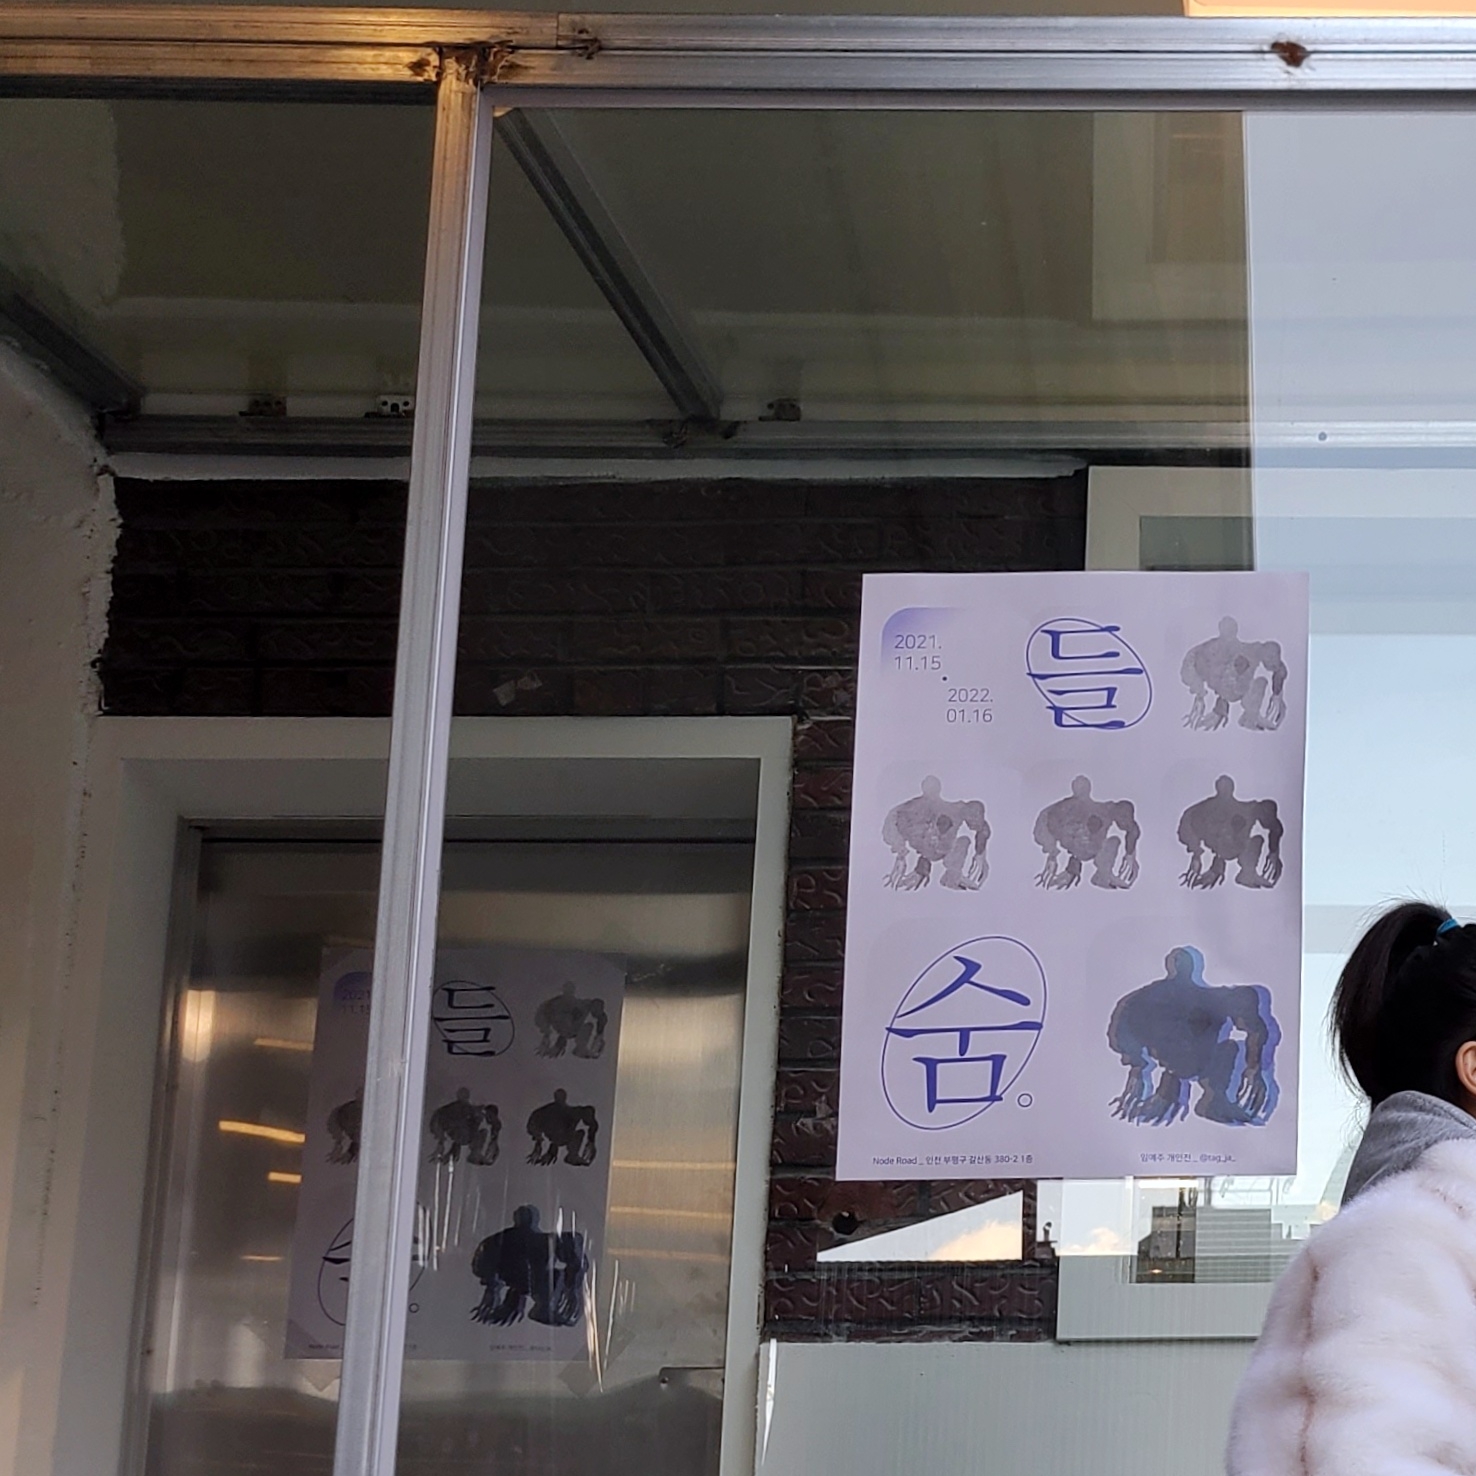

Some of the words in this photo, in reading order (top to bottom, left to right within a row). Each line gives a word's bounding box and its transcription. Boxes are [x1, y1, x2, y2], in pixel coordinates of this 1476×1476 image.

[894, 634, 942, 650] 2021.
[894, 655, 942, 671] 11.15
[1026, 625, 1144, 728] 들
[947, 688, 993, 703] 2022.
[946, 708, 993, 723] 01.16
[872, 1156, 894, 1165] Node
[896, 1156, 918, 1165] Road
